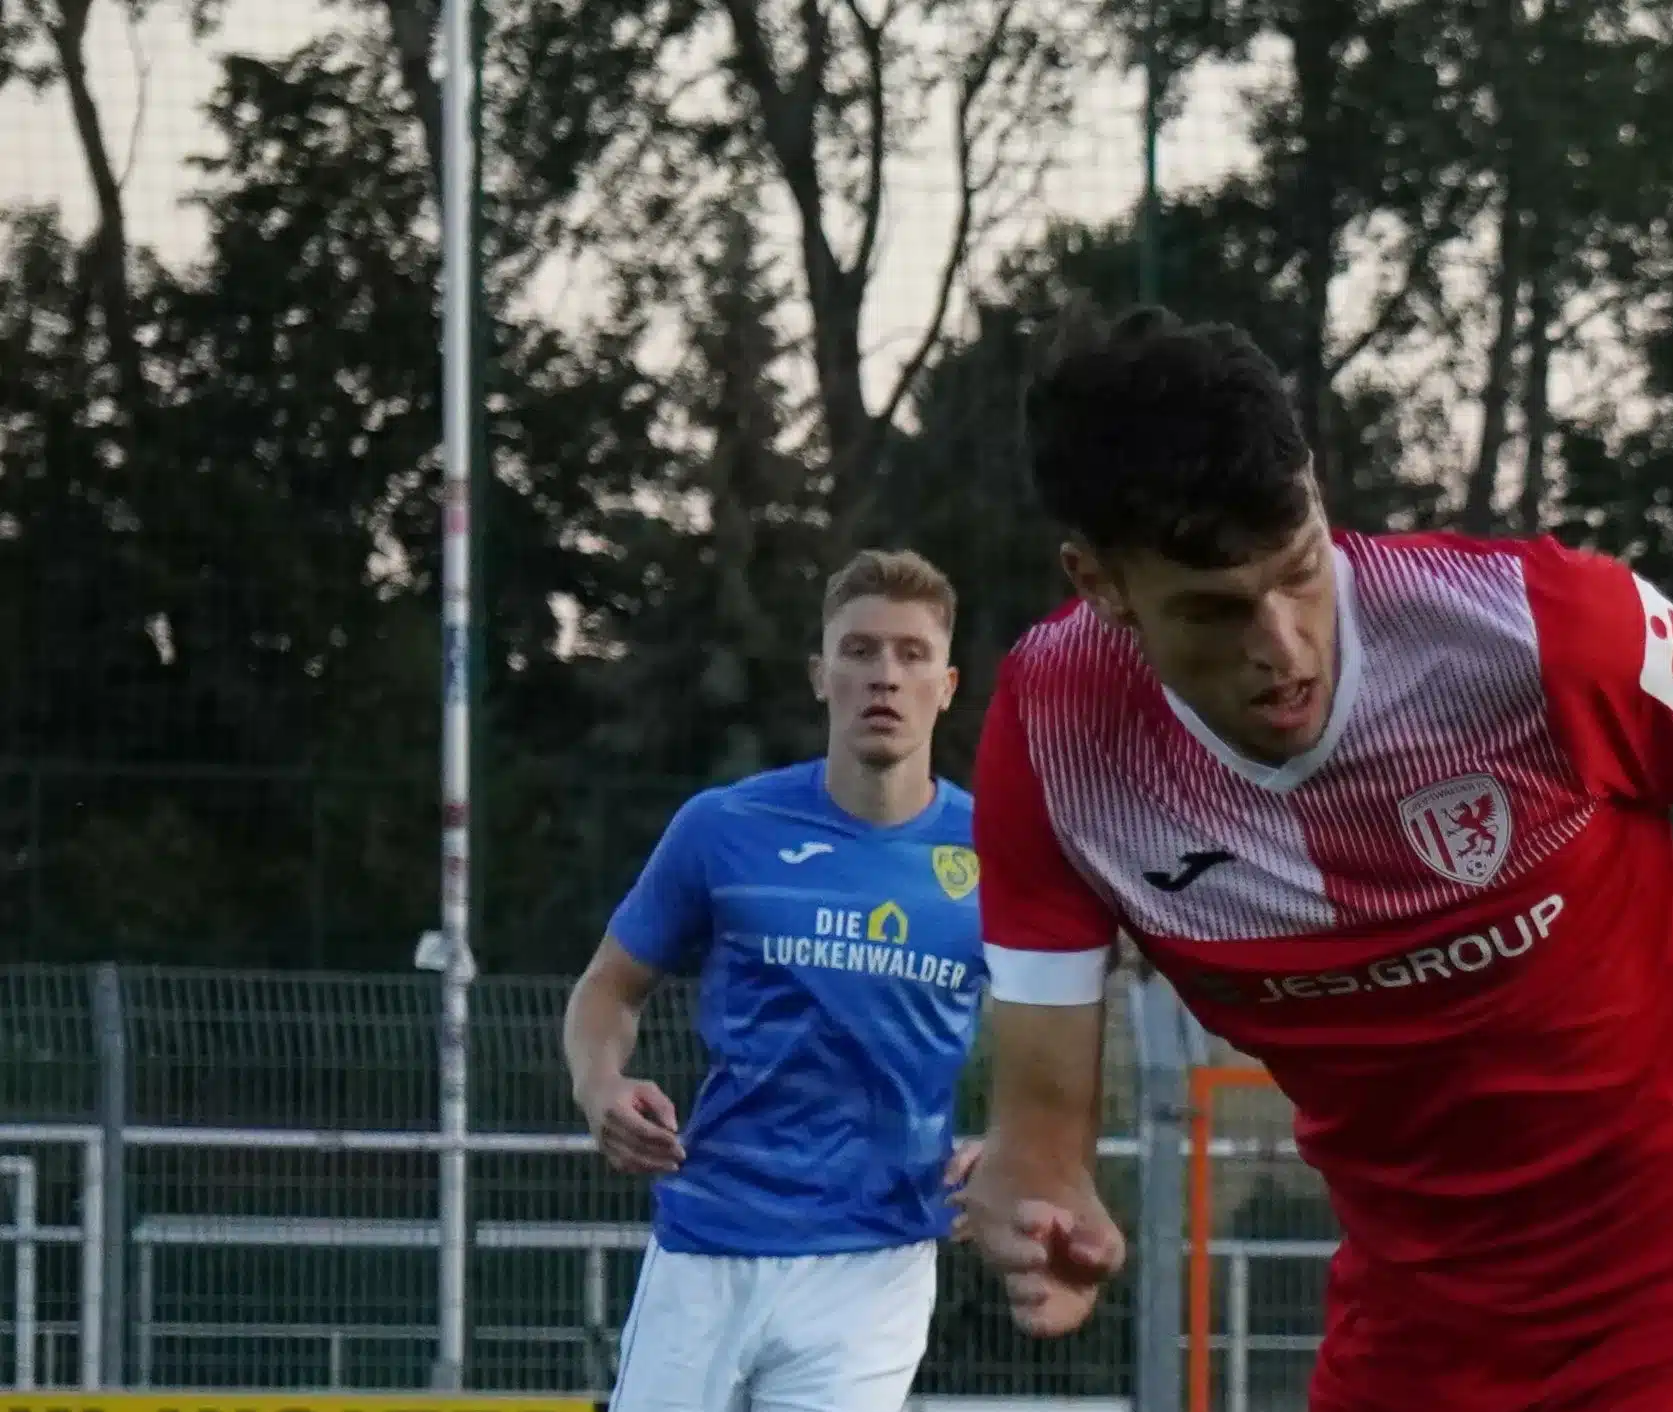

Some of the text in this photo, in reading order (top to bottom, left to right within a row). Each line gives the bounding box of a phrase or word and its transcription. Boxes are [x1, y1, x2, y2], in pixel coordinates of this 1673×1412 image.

[814, 906, 863, 940] DIE
[1259, 892, 1566, 1004] JES.GROUP
[762, 935, 968, 991] LUCKENWALDER
